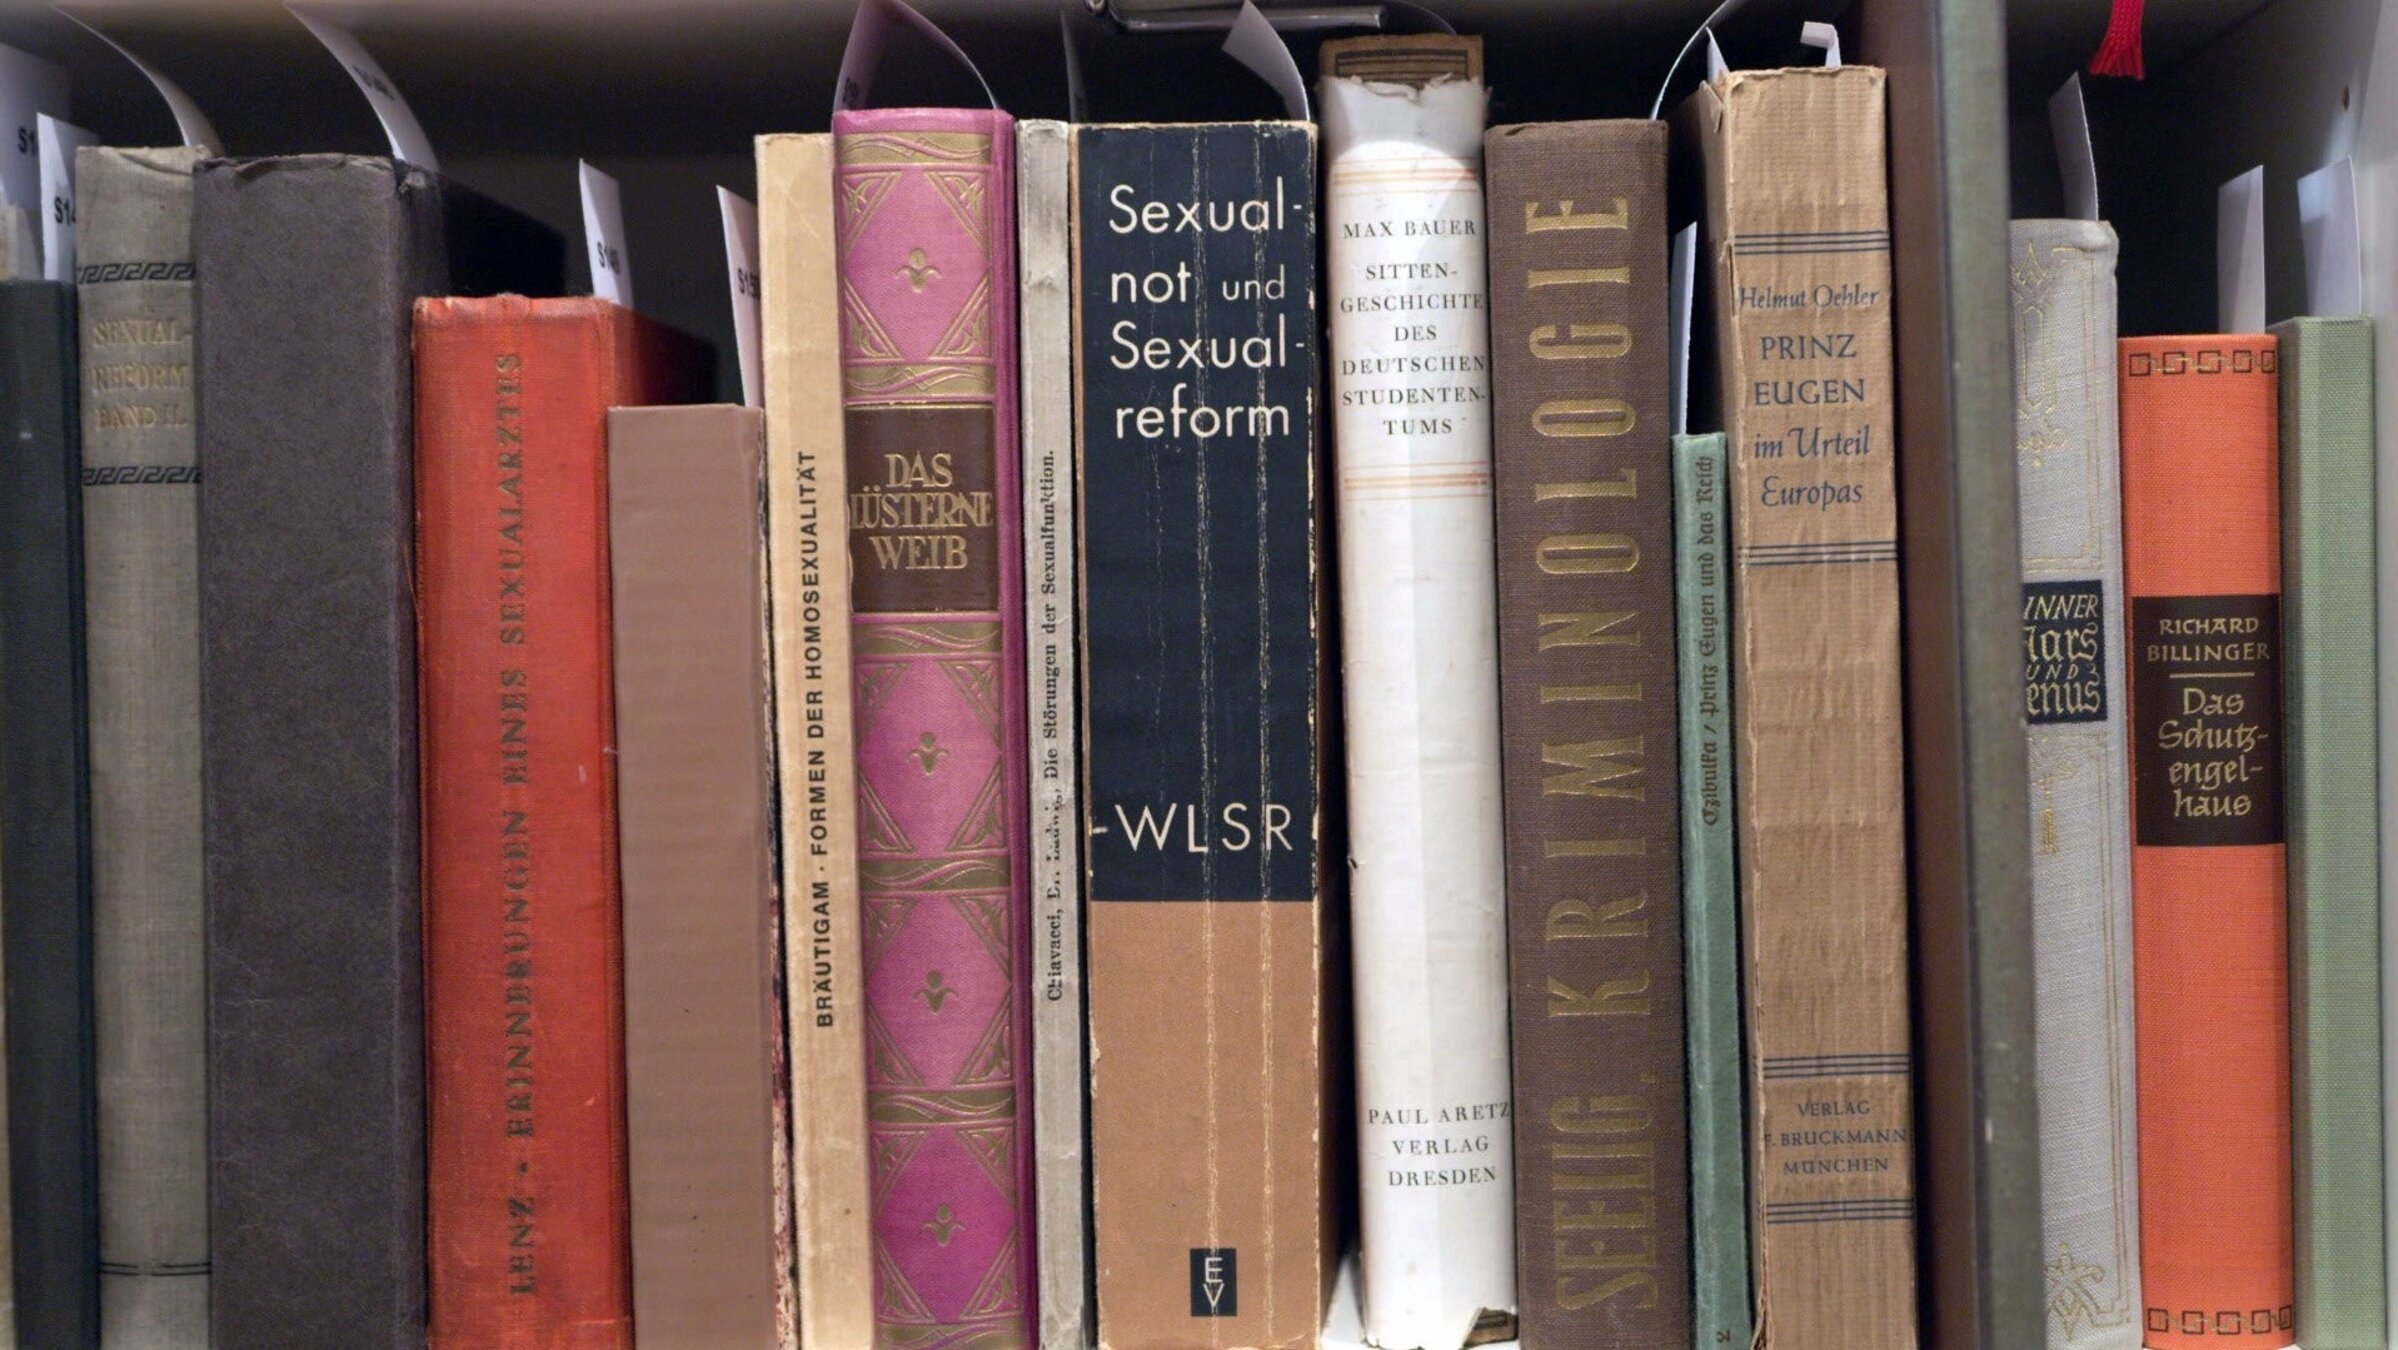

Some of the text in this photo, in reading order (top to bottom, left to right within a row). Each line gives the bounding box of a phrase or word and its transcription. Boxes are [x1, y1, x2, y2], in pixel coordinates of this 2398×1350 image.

[1108, 175, 1303, 234] Sexual-
[1342, 219, 1477, 239] MAX BAUER
[1110, 261, 1286, 303] not und
[1365, 261, 1458, 281] SITTEN-
[1340, 293, 1484, 313] GESCHICHTE
[1738, 283, 1880, 309] Helmut Oehler
[1109, 312, 1305, 370] Sexual-
[1394, 325, 1438, 342] DES
[1760, 333, 1858, 361] PRINZ
[1342, 355, 1486, 376] DEUTSCHEN
[1342, 386, 1487, 406] STUDENTEN-
[1753, 377, 1866, 406] EUGEN
[1115, 382, 1290, 439] reform
[1383, 418, 1453, 436] TUMS
[1754, 424, 1871, 459] im Urteil
[883, 450, 954, 488] DAS
[1695, 456, 1714, 502] Reich
[850, 484, 994, 529] LÜSTERNE
[1760, 475, 1863, 512] Europas
[1039, 450, 1057, 595] Sexualfunktion.
[1696, 511, 1715, 545] das
[868, 534, 969, 570] WEIB
[1697, 551, 1715, 587] und
[1041, 603, 1057, 634] der
[1525, 198, 1651, 1019] KRIMINOLOGIE
[1699, 593, 1718, 657] Eugen
[2159, 616, 2260, 636] RICHARD
[2146, 641, 2271, 662] BILLINGER
[1042, 643, 1060, 740] Störungen
[1700, 664, 1720, 718] Prinz
[2182, 687, 2245, 716] Das
[501, 669, 529, 786] EINES
[797, 451, 834, 1028] BRÄUTIGAM FORMEN DER HOMOSEXUALITÄT
[2158, 718, 2269, 753] Schutz-
[1043, 747, 1059, 780] Die
[2168, 754, 2264, 791] engel-
[2173, 788, 2252, 817] haus
[502, 809, 536, 1138] ERINNERUNGEN
[1367, 1101, 1511, 1125] PAUL ARETZ
[1797, 1101, 1871, 1117] VERLAG
[1392, 1135, 1490, 1155] VERLAG
[1780, 1128, 1907, 1147] BRUCKMANN
[1388, 1165, 1497, 1187] DRESDEN
[506, 1196, 537, 1297] LENZ
